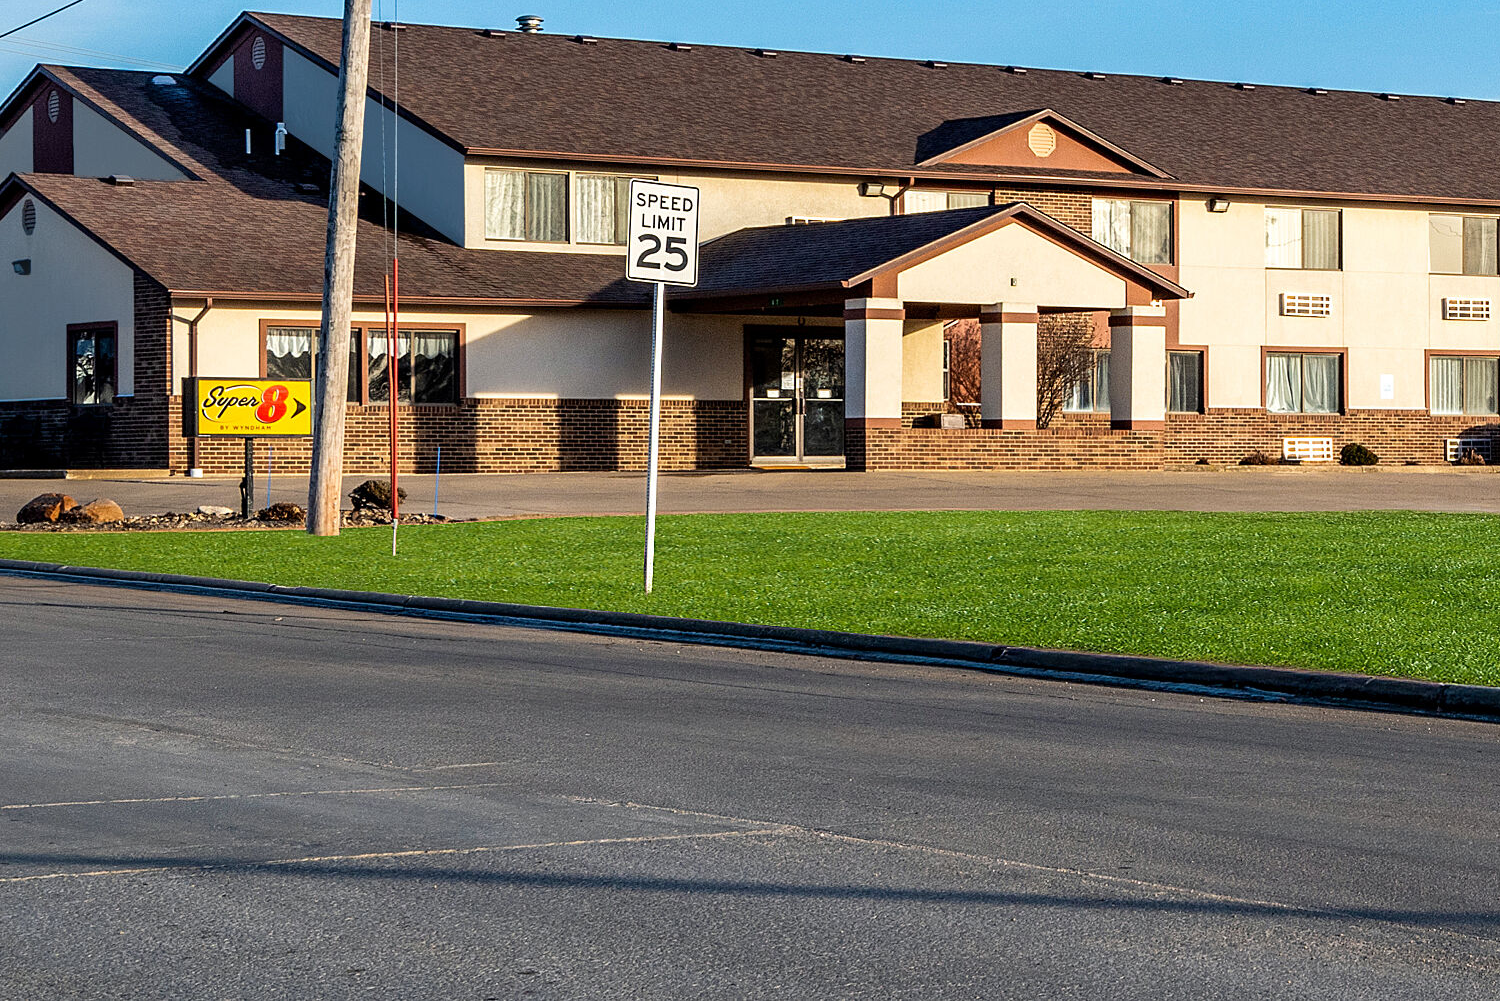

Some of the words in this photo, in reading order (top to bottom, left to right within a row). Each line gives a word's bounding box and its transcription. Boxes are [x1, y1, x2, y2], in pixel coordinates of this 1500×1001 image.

[637, 193, 693, 212] SPEED
[642, 213, 686, 232] LIMIT
[636, 234, 688, 272] 25
[202, 386, 259, 419] Super
[255, 385, 289, 424] 8
